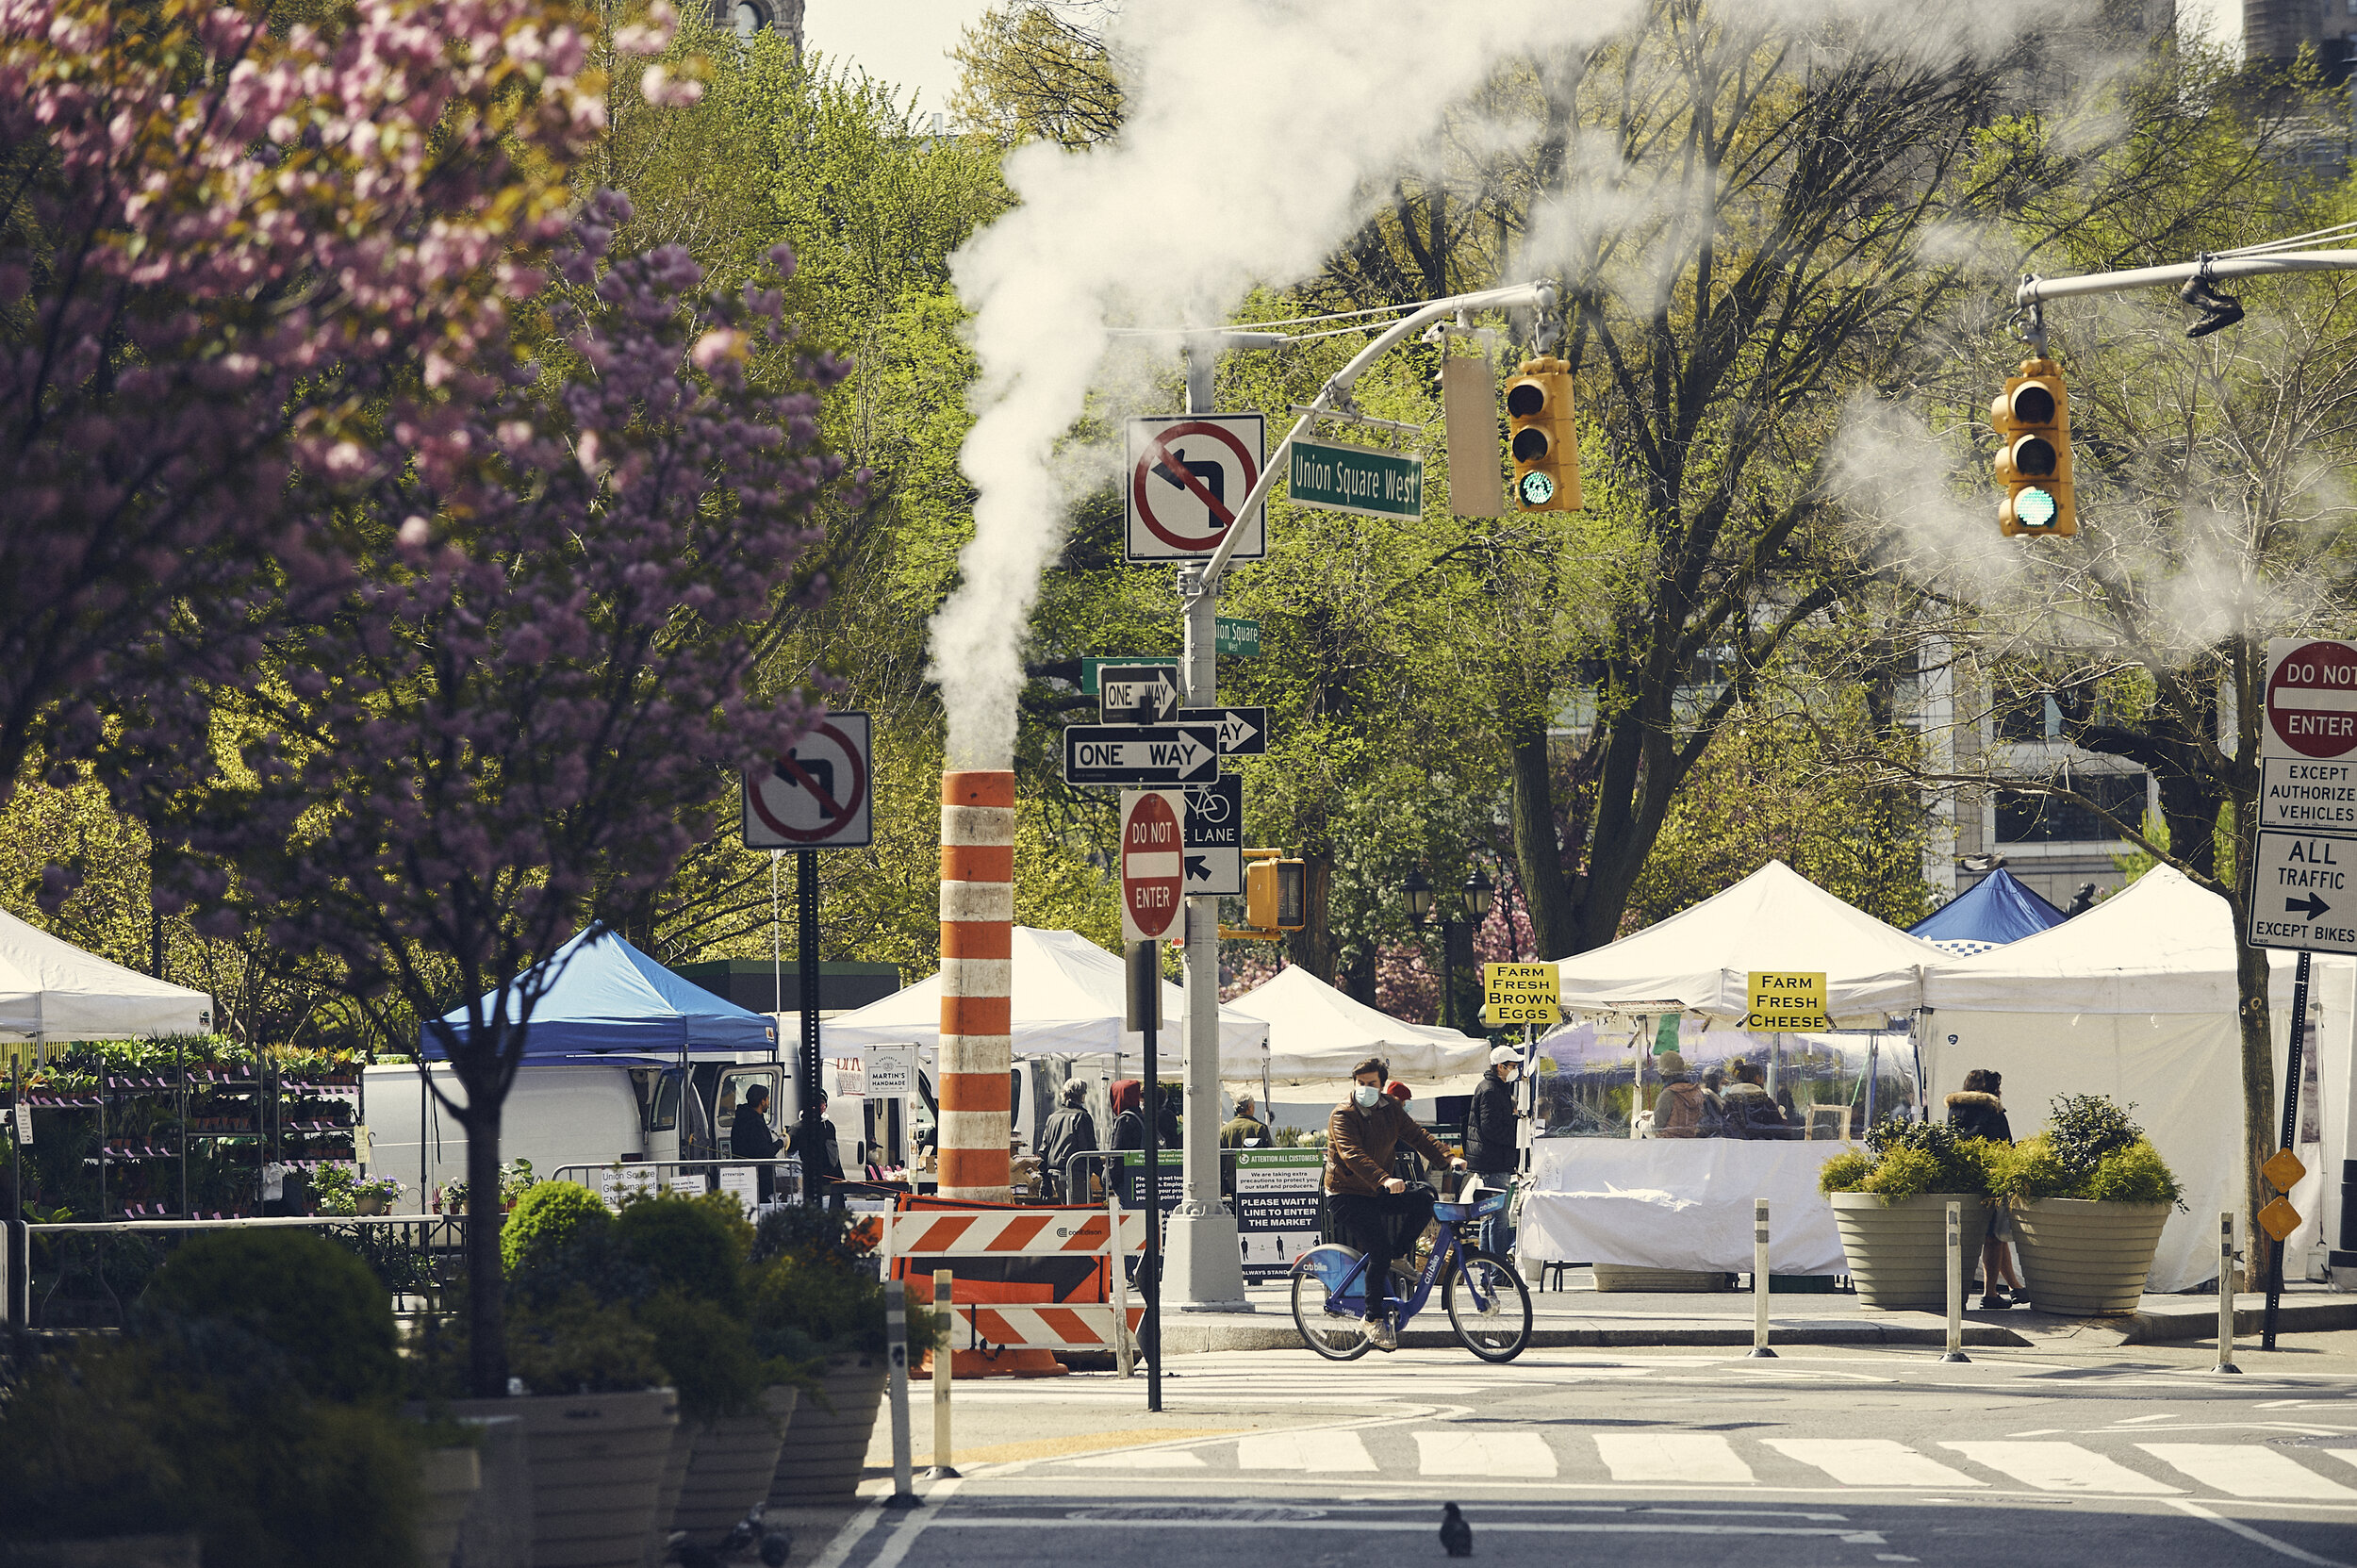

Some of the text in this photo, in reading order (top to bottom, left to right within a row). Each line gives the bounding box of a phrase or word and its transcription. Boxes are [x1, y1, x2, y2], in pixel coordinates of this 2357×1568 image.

[1296, 454, 1416, 503] Union Square West
[1215, 620, 1258, 645] ion Square
[2287, 663, 2315, 683] DO
[1108, 684, 1168, 706] ONE WAY
[1219, 723, 1244, 741] AY
[2288, 715, 2354, 736] ENTER
[1079, 744, 1197, 766] ONE WAY
[2289, 765, 2349, 781] EXCEPT
[2269, 784, 2356, 801] AUTHORIZE
[2279, 805, 2354, 822] VEHICLES
[1132, 822, 1147, 844] DO
[1151, 822, 1172, 843] NOT
[1195, 828, 1235, 842] LANE
[2288, 840, 2337, 865] ALL
[2278, 867, 2345, 890] TRAFFIC
[1136, 886, 1170, 909] ENTER
[2256, 921, 2356, 943] EXCEPT BIKES
[1289, 1154, 1319, 1162] CUSTOMERS
[603, 1171, 655, 1181] Union Squre
